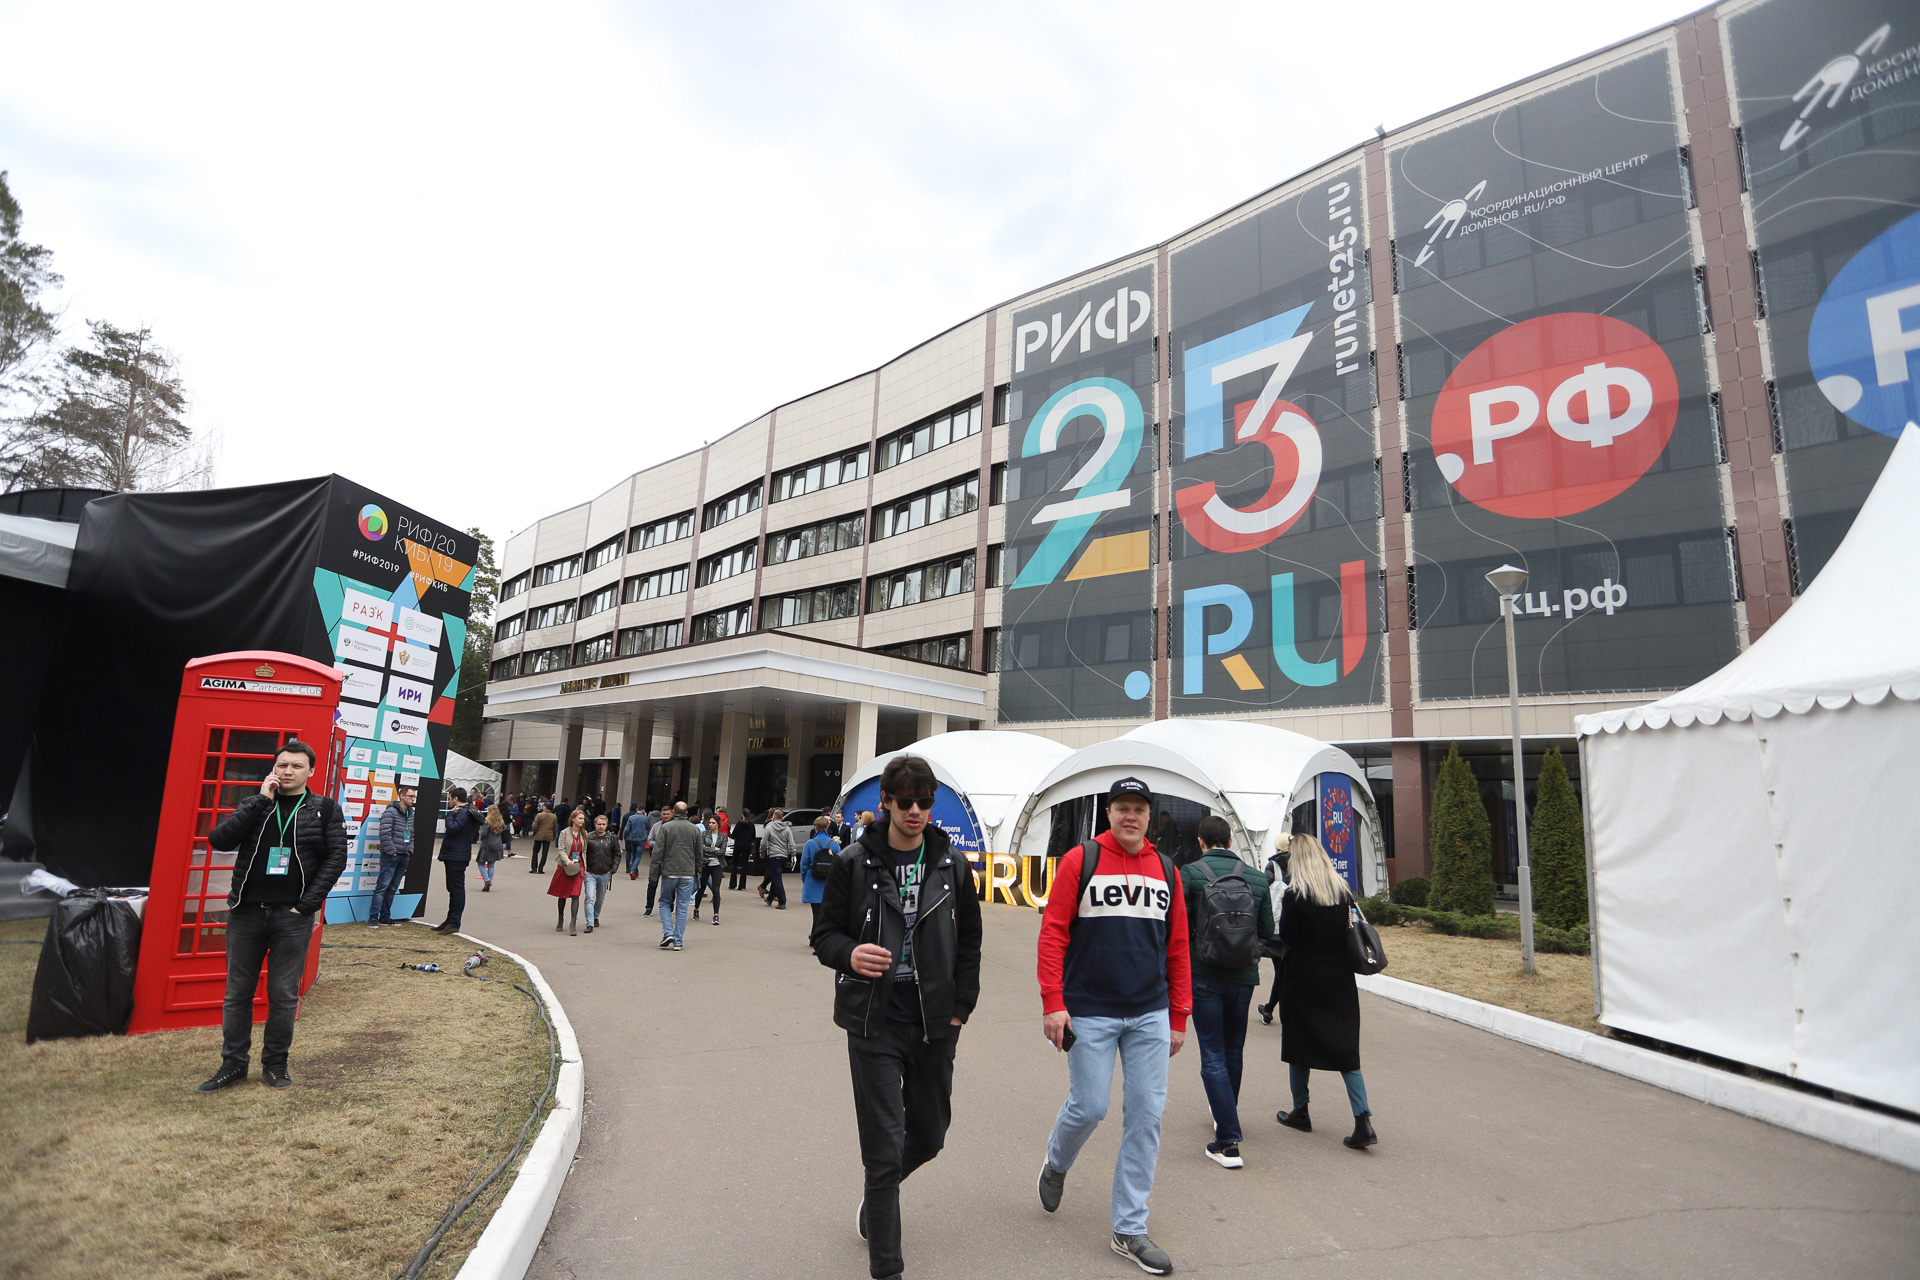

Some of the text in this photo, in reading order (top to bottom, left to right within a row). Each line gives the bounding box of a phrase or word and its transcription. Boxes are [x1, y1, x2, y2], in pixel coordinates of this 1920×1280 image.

[1866, 43, 1920, 77] КООР
[1850, 62, 1920, 102] ДОМЕН
[1470, 153, 1649, 219] КООРДИНАЦИОННЫЙ ЦЕНТР
[1460, 209, 1519, 237] ДОМЕНОВ
[1327, 181, 1359, 376] runet25.ru
[1014, 286, 1151, 374] РИФ
[1435, 362, 1653, 484] .РФ
[352, 548, 400, 573] #РИФ2019
[409, 570, 448, 593] #РИФКИБ
[352, 601, 384, 621] РАЭК
[1499, 578, 1628, 619] кц.рф
[415, 622, 437, 635] РОЦИТ
[1124, 559, 1368, 700] .RU
[202, 678, 247, 690] AGIMA
[298, 685, 322, 696] Club
[398, 686, 422, 703] ИРИ
[400, 724, 419, 732] center
[936, 820, 942, 828] 7
[948, 834, 979, 848] 994 года
[1338, 860, 1348, 870] лет
